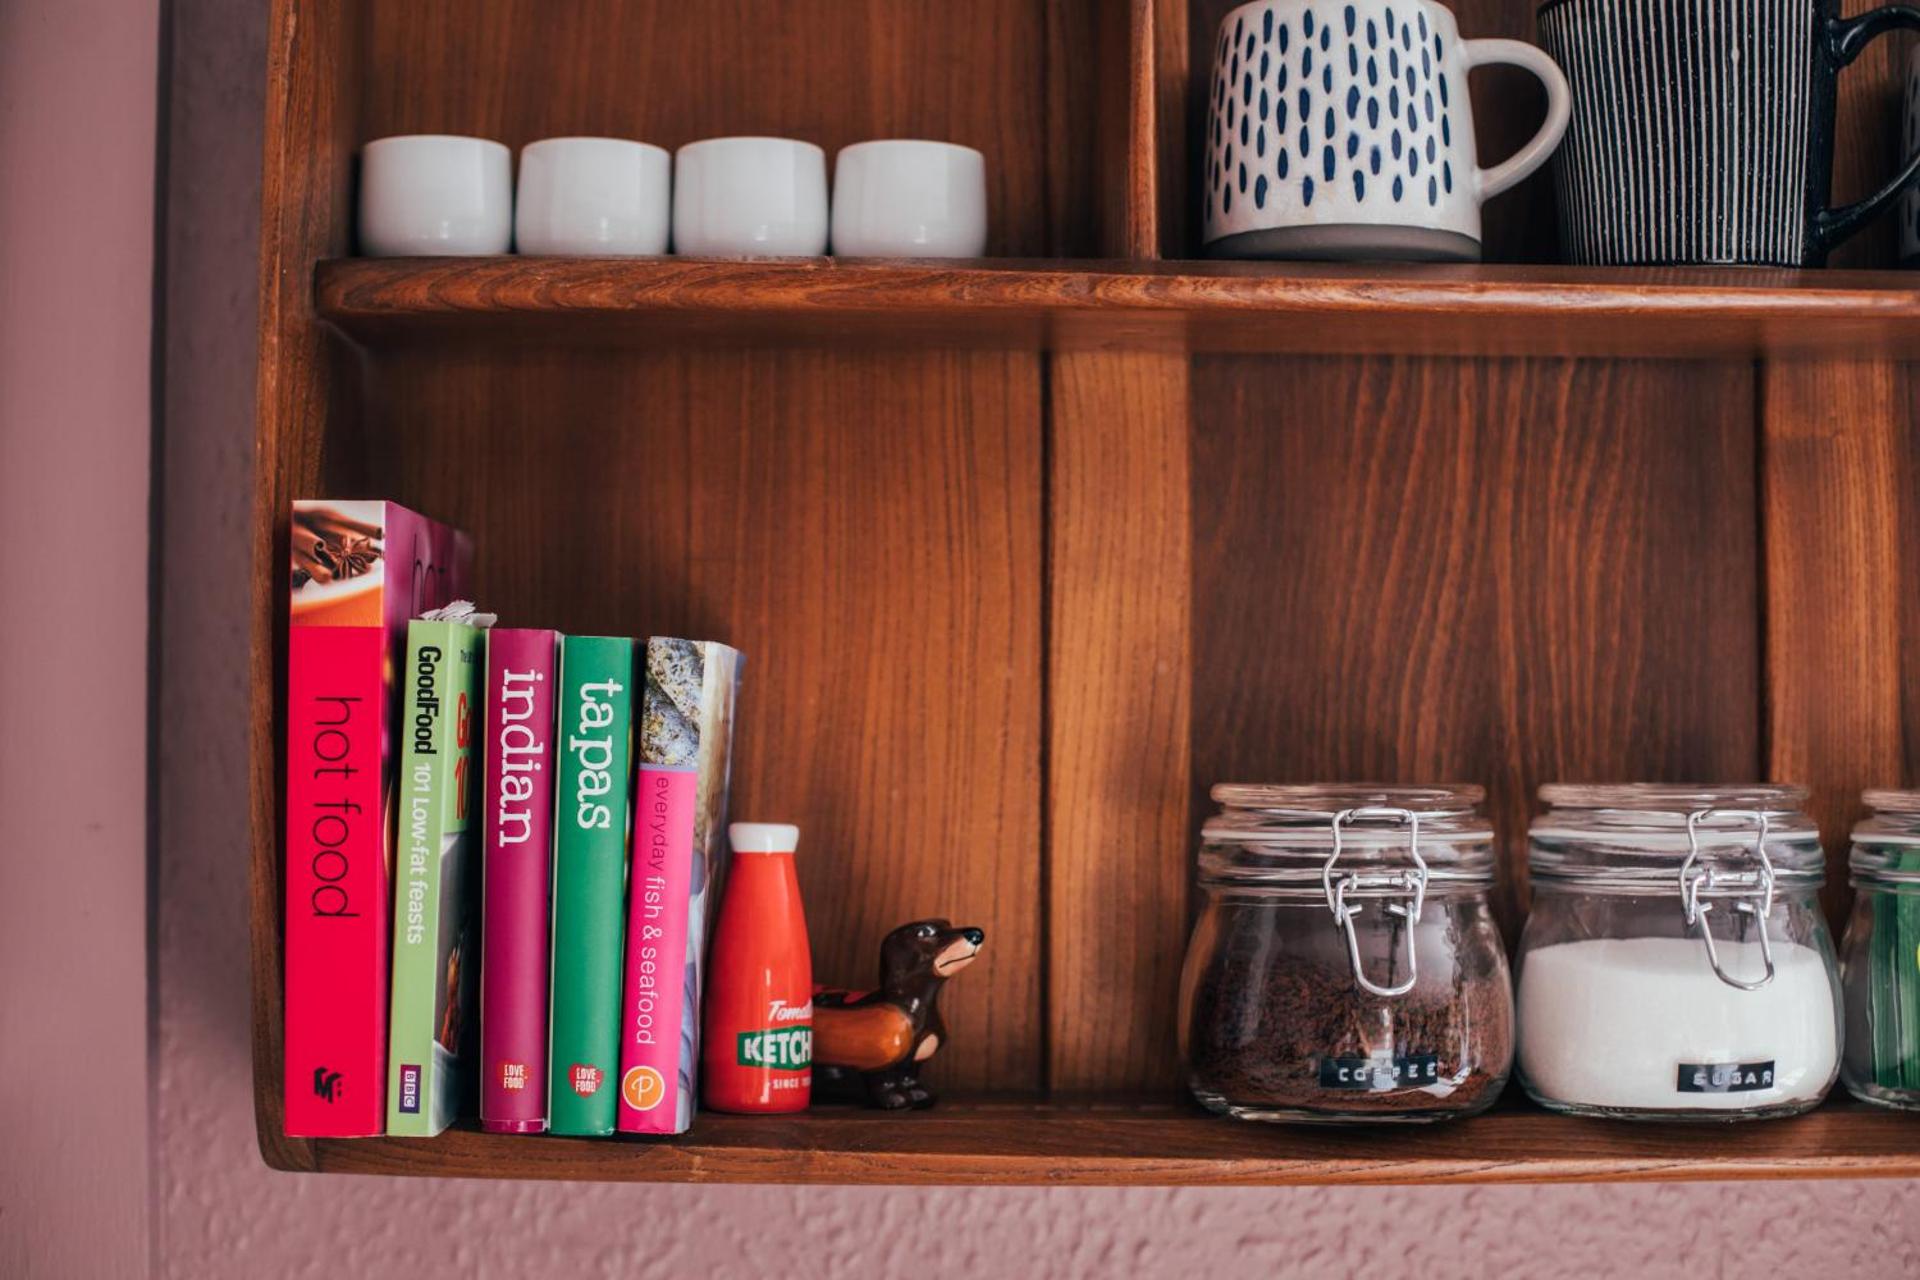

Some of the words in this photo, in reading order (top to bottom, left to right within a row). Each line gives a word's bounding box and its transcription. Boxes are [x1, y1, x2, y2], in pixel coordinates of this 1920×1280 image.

[413, 645, 442, 755] GoodFood
[313, 696, 363, 780] hot
[498, 669, 544, 848] indian
[569, 678, 624, 829] tapas
[412, 762, 431, 792] 101
[409, 797, 430, 876] Low-fat
[647, 777, 670, 872] everyday
[311, 798, 362, 918] food
[407, 879, 429, 945] feasts
[643, 876, 666, 919] fish
[641, 925, 663, 940] &
[636, 946, 658, 1046] seafood
[403, 1070, 417, 1108] BBC
[503, 1077, 525, 1089] FOOD
[504, 1064, 524, 1077] LOVE
[575, 1080, 596, 1093] FOOD
[576, 1067, 596, 1080] LOVE
[772, 1078, 799, 1089] SINCE
[1692, 1069, 1773, 1086] SUGAR
